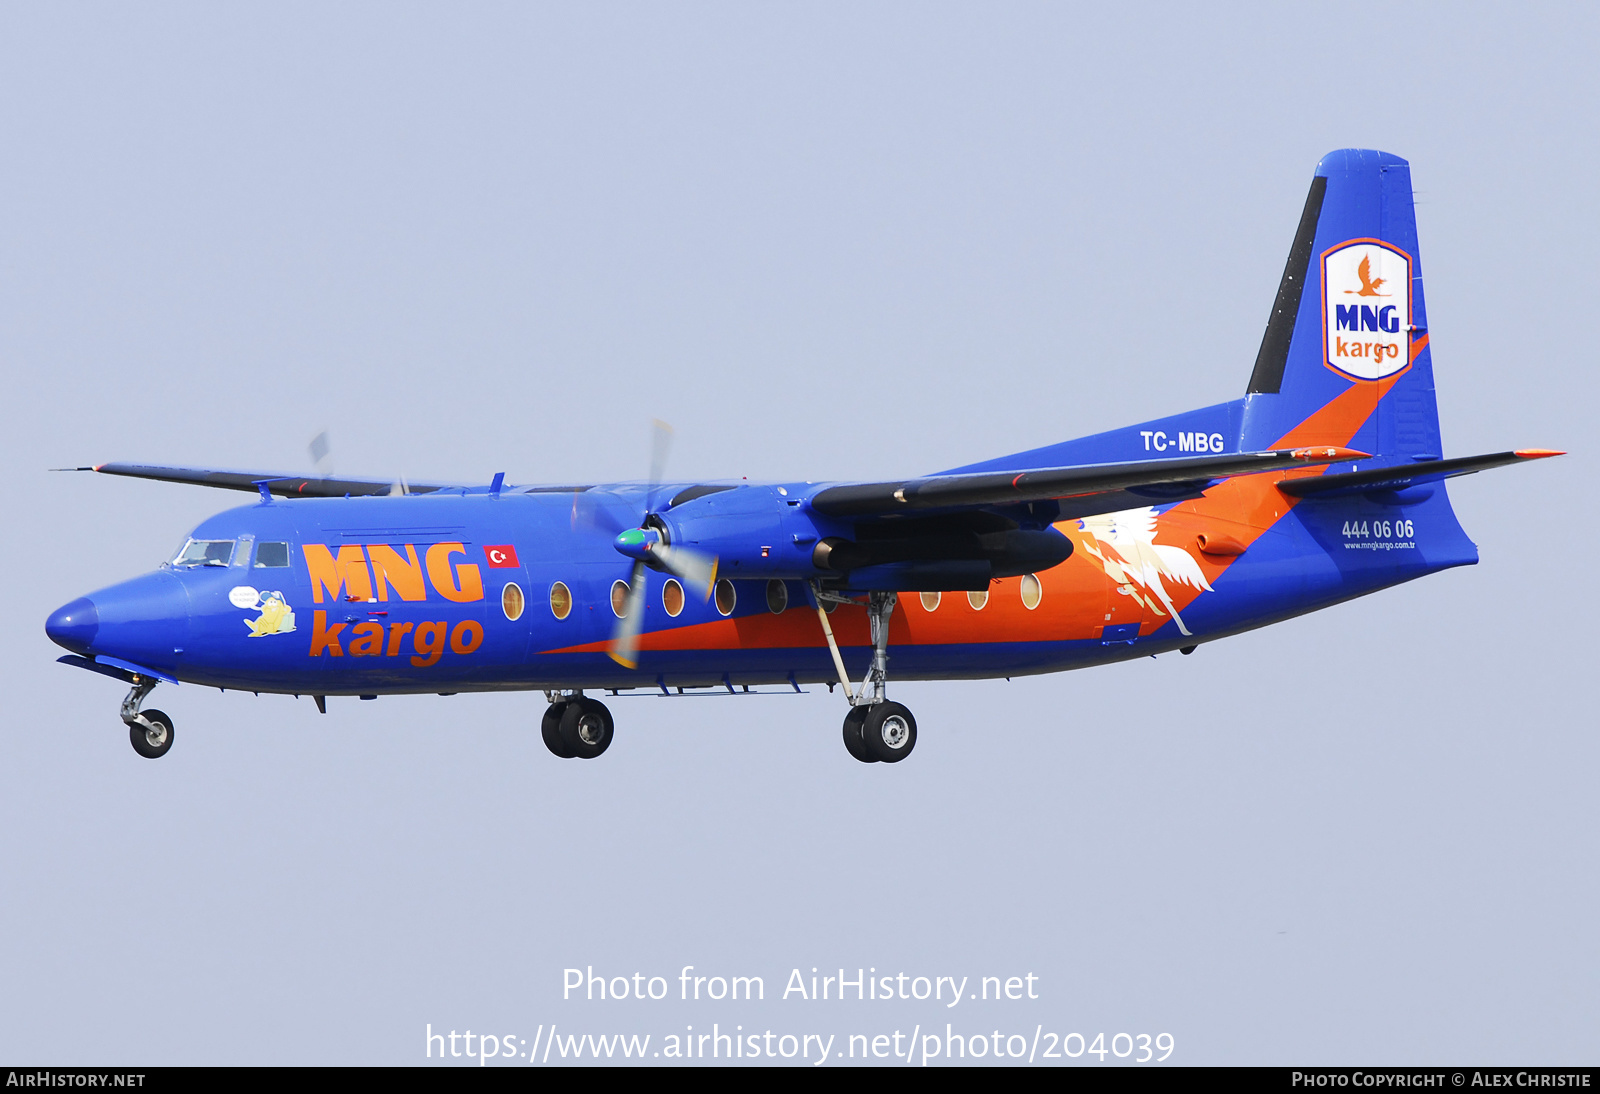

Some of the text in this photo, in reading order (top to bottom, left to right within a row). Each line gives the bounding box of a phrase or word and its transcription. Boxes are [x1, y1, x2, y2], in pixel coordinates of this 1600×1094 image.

[1336, 304, 1399, 333] MNG
[1336, 336, 1399, 364] kargo
[1140, 431, 1224, 453] TC-MBG
[1342, 519, 1414, 538] 444 06 06
[1344, 541, 1416, 551] www.mngkargo.com.tr
[302, 541, 485, 604] MNG
[309, 610, 484, 667] kargo
